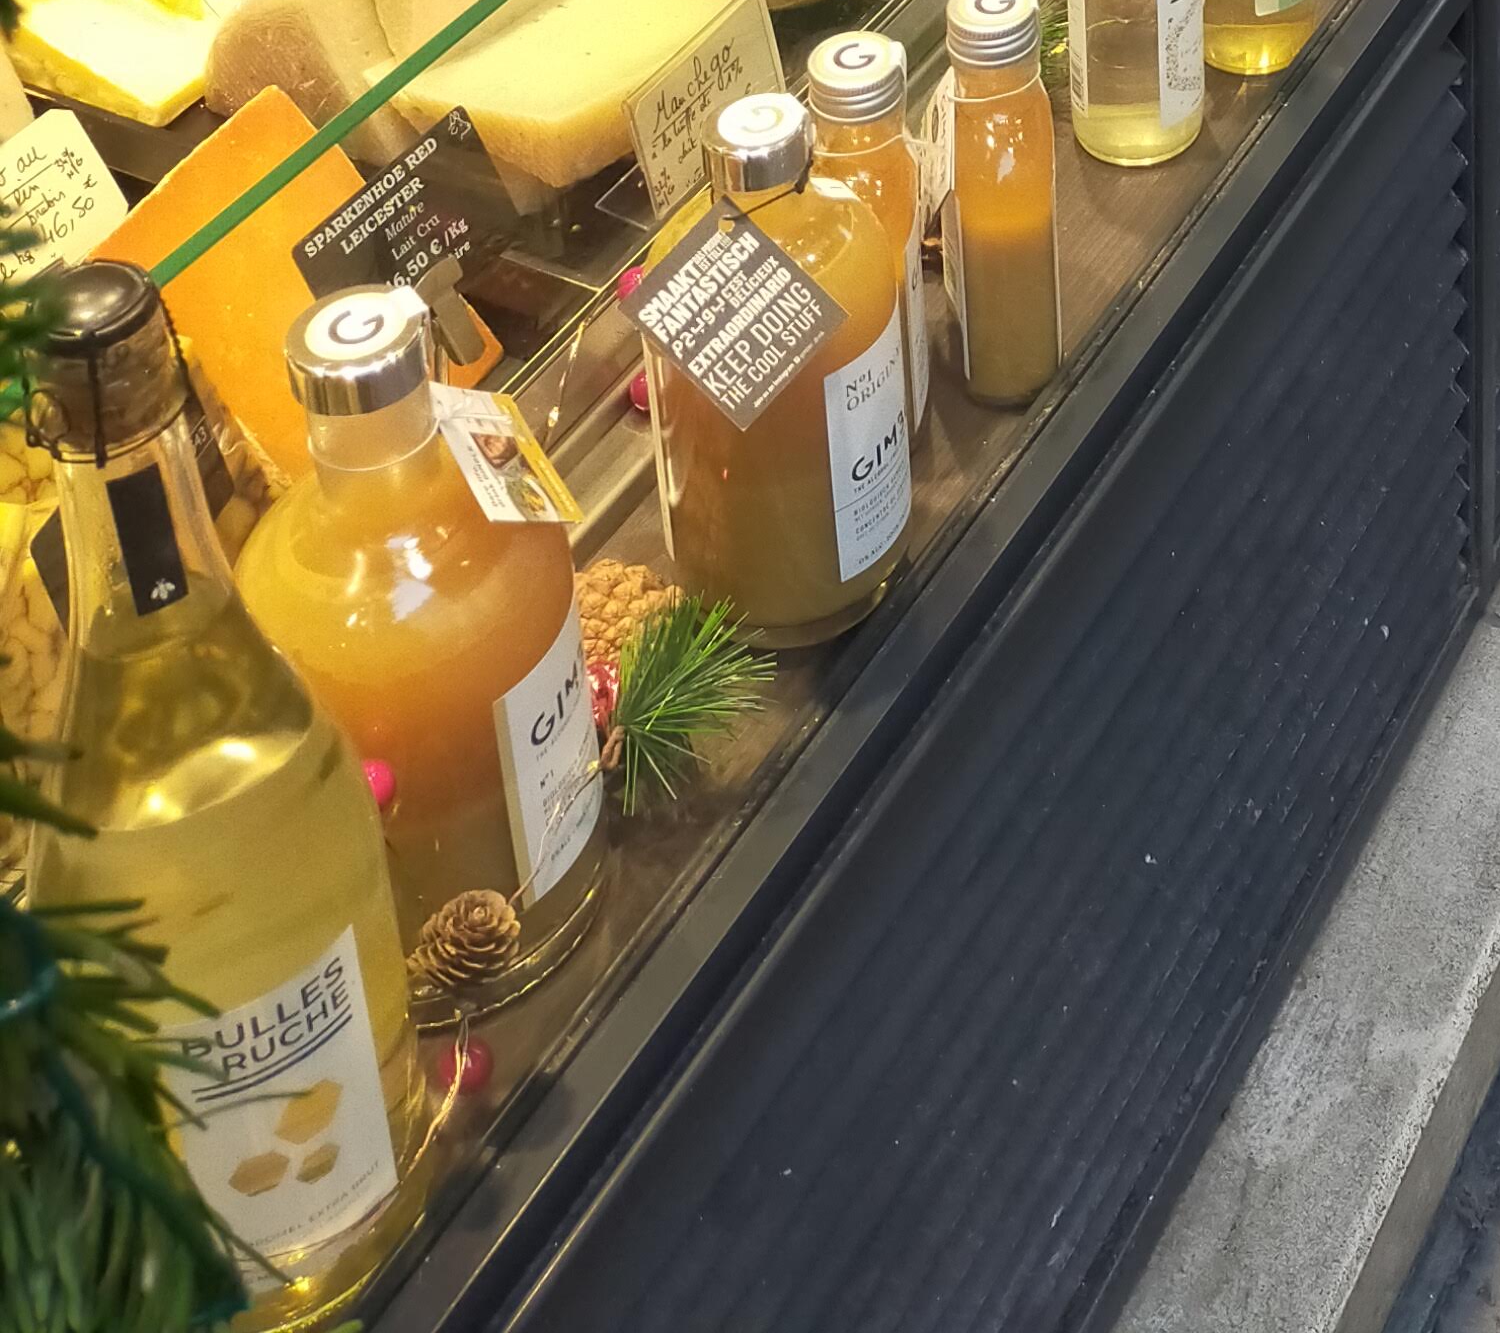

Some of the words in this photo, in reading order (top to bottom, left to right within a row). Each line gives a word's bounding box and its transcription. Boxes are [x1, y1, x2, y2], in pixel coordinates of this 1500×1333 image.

[832, 40, 880, 73] G
[304, 164, 407, 259] SPARKENHOE
[404, 136, 438, 171] RED
[339, 176, 425, 255] LEICESTER
[391, 234, 417, 261] Lait
[416, 213, 441, 238] Cru
[386, 250, 430, 288] 6,50
[429, 238, 443, 256] €
[638, 257, 702, 328] SMAAKT
[652, 230, 761, 345] FANTASTISCH
[720, 269, 750, 299] C'EST
[327, 309, 385, 345] G
[687, 266, 793, 378] EXTRAORDINARIO
[702, 339, 754, 398] KEEP
[749, 281, 812, 348] DOING
[719, 377, 754, 412] THE
[747, 344, 788, 384] COOL
[780, 298, 824, 348] STUFF
[181, 955, 346, 1059] BULLES
[221, 980, 351, 1074] RUCHE
